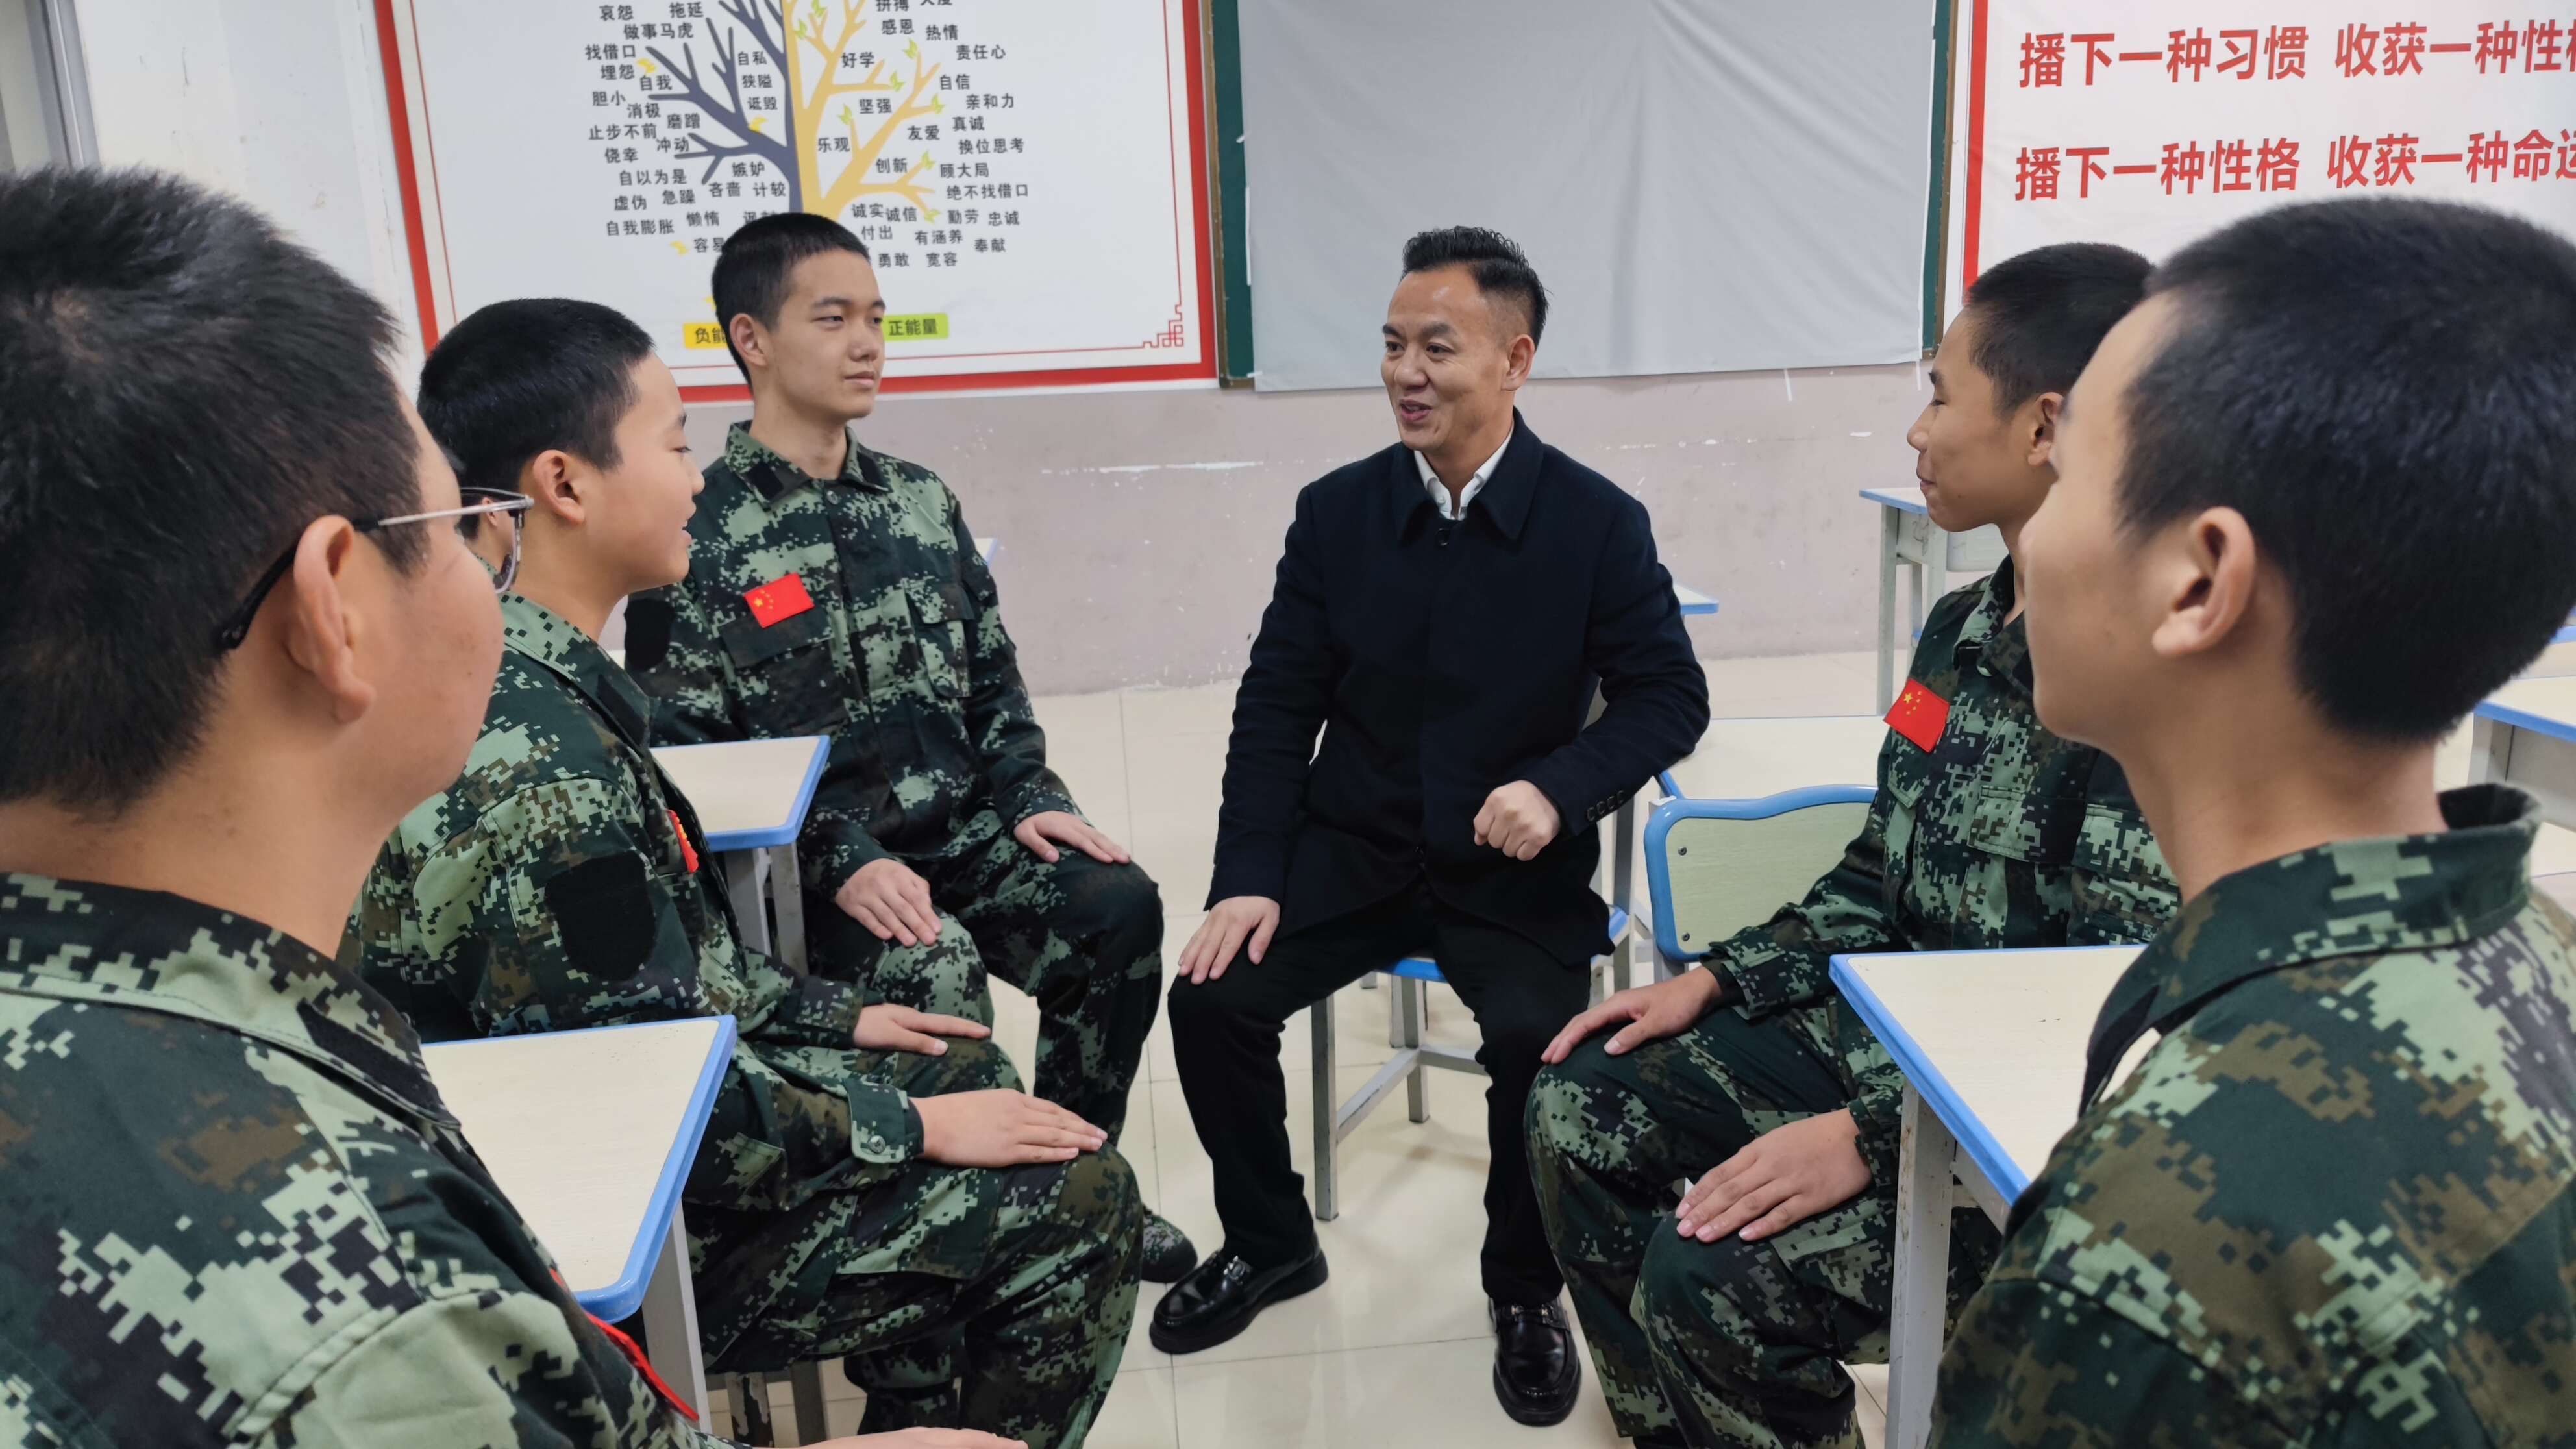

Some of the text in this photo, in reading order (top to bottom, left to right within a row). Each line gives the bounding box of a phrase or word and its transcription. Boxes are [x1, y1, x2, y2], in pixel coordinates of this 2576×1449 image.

[599, 5, 634, 21] 哀怨
[669, 1, 704, 18] 拖延
[623, 22, 694, 40] 做事马虎
[882, 19, 915, 35] 感恩
[926, 25, 959, 40] 热情
[585, 43, 636, 60] 找借口
[737, 51, 767, 66] 自私
[956, 44, 1006, 60] 责任心
[2020, 19, 2576, 88] 播下一种习惯 收获一种性
[841, 52, 875, 68] 好学
[601, 64, 635, 80] 埋怨
[639, 75, 673, 91] 自我
[940, 74, 971, 90] 自信
[592, 90, 626, 106] 胆小
[747, 97, 778, 110] 诋毁
[966, 93, 1015, 109] 亲和力
[627, 103, 661, 118] 消极
[859, 99, 892, 114] 坚强
[667, 113, 701, 129] 磨蹭
[952, 116, 985, 132] 真诚
[588, 123, 657, 140] 止步不前
[908, 125, 940, 141] 友爱
[656, 137, 689, 153] 冲动
[817, 137, 850, 152] 乐观
[958, 138, 1024, 155] 换位思考
[604, 147, 639, 163] 侥幸
[732, 162, 765, 177] 嫉妒
[876, 158, 908, 173] 创新
[940, 162, 989, 178] 顾大局
[2015, 138, 2300, 201] 播下一种性格
[619, 169, 687, 186] 自以为是
[662, 189, 696, 205] 急躁
[709, 182, 741, 197] 吝啬
[752, 182, 786, 197] 计较
[947, 184, 1029, 200] 绝不找借口
[613, 195, 647, 211] 虚伪
[686, 211, 720, 227] 懒惰
[947, 209, 979, 224] 勤劳
[988, 210, 1021, 226] 忠诚
[606, 219, 675, 236] 自我膨胀
[861, 226, 893, 240] 付出
[914, 229, 963, 245] 有涵养
[974, 238, 1006, 253] 奉献
[878, 253, 910, 268] 勇敢
[926, 252, 958, 267] 宽容
[889, 319, 938, 336] 正能量
